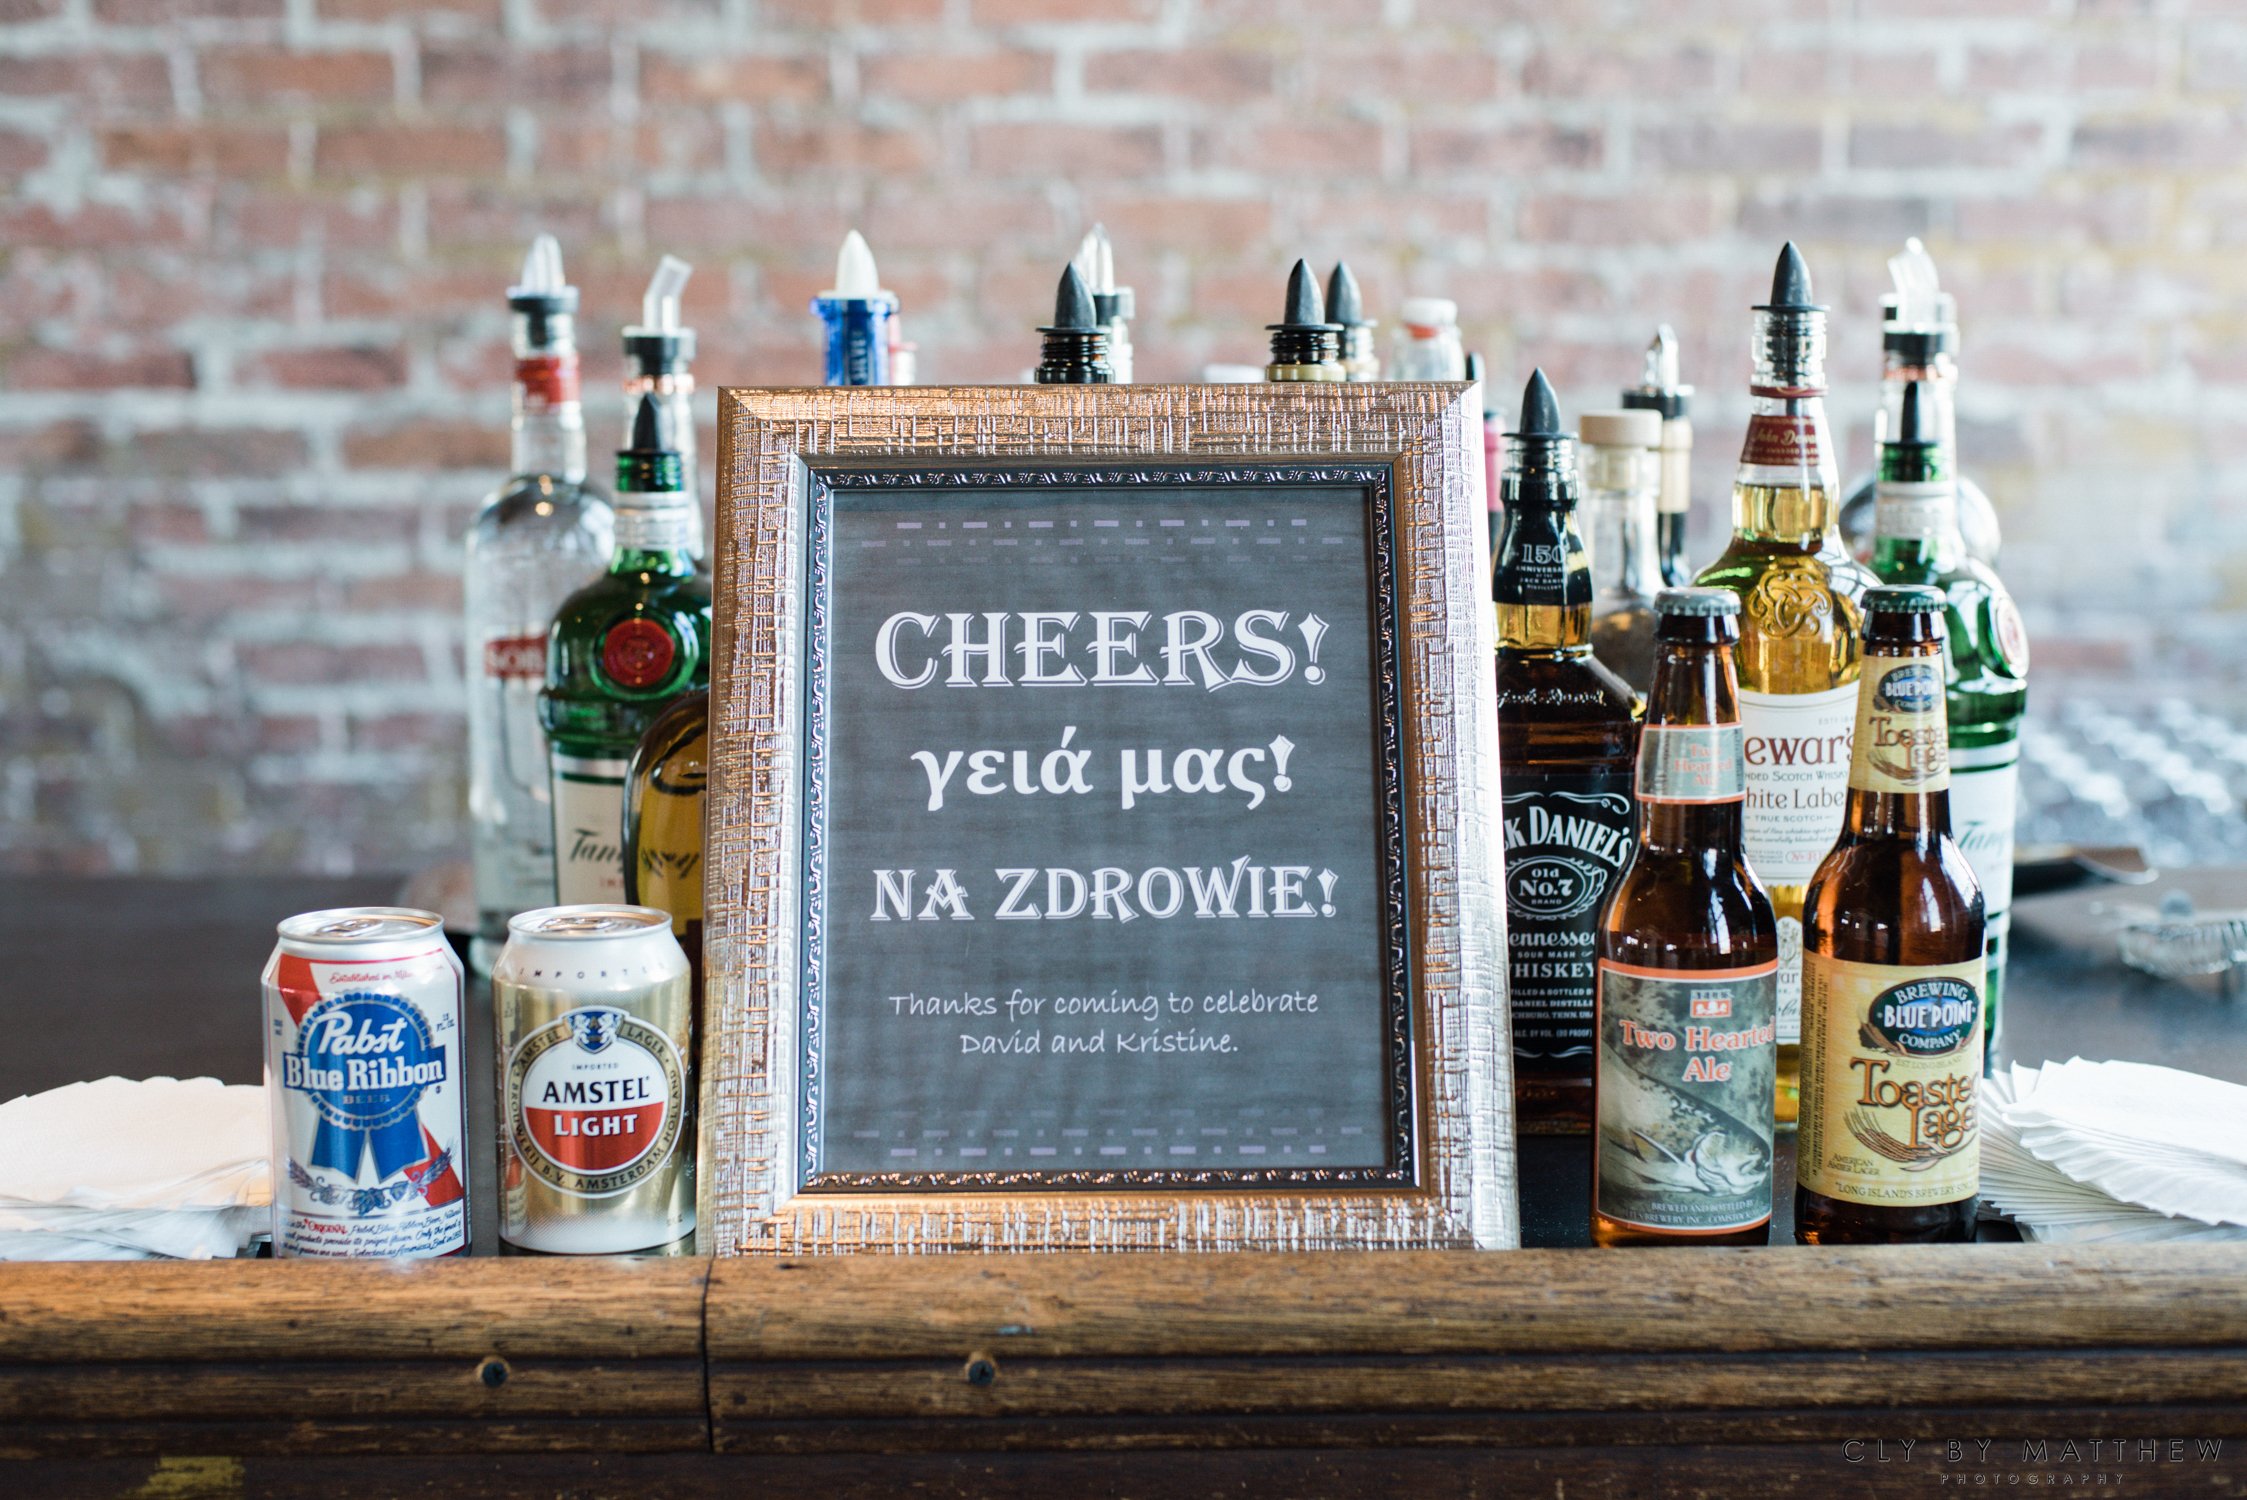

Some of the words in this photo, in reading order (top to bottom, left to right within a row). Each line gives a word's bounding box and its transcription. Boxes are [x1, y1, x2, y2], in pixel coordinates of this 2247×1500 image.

[1516, 565, 1564, 573] ANNIVERSA
[874, 610, 1330, 694] CHEERS!
[1743, 726, 1854, 766] ewar's
[910, 725, 1094, 812] γειά
[1121, 733, 1296, 810] μας!
[1743, 772, 1769, 781] NDED
[1745, 786, 1788, 809] hite
[1793, 785, 1845, 809] Labe
[1755, 814, 1781, 823] TRUE
[1783, 814, 1823, 823] SCOTCH
[1528, 805, 1633, 867] DANIEL'S
[1531, 868, 1560, 878] Old
[869, 868, 975, 921] NA
[994, 855, 1340, 924] ZDROWIE!
[1518, 878, 1574, 897] No.7
[1508, 931, 1595, 947] ennesse
[1509, 962, 1594, 978] HISKEY
[1510, 988, 1538, 996] TILLED
[1549, 999, 1593, 1007] DISTILL
[1894, 980, 1969, 1004] BREWING
[888, 990, 998, 1017] Thanks
[1005, 988, 1046, 1023] for
[1054, 989, 1160, 1021] coming
[1168, 990, 1194, 1015] to
[1202, 988, 1320, 1015] celebrate
[1883, 1005, 1927, 1029] BLUE
[1930, 1000, 1973, 1028] POINT
[315, 1011, 408, 1056] Pabst
[626, 1026, 666, 1056] LAGER
[960, 1030, 1041, 1055] David
[1051, 1031, 1106, 1054] and
[1116, 1029, 1240, 1055] Kristine.
[1619, 1018, 1677, 1051] Two
[1684, 1014, 1777, 1052] Hearted
[1898, 1030, 1962, 1049] COMPANY
[285, 1054, 344, 1091] Blue
[347, 1056, 444, 1091] Ribbon
[572, 1062, 620, 1071] IMPORTED
[1681, 1056, 1733, 1082] Ale
[542, 1077, 650, 1104] AMSTEL
[553, 1113, 639, 1138] LIGHT
[574, 1148, 665, 1188] AMSTERDAM
[663, 1069, 680, 1143] HOLLAND
[1904, 1100, 1979, 1150] Lage
